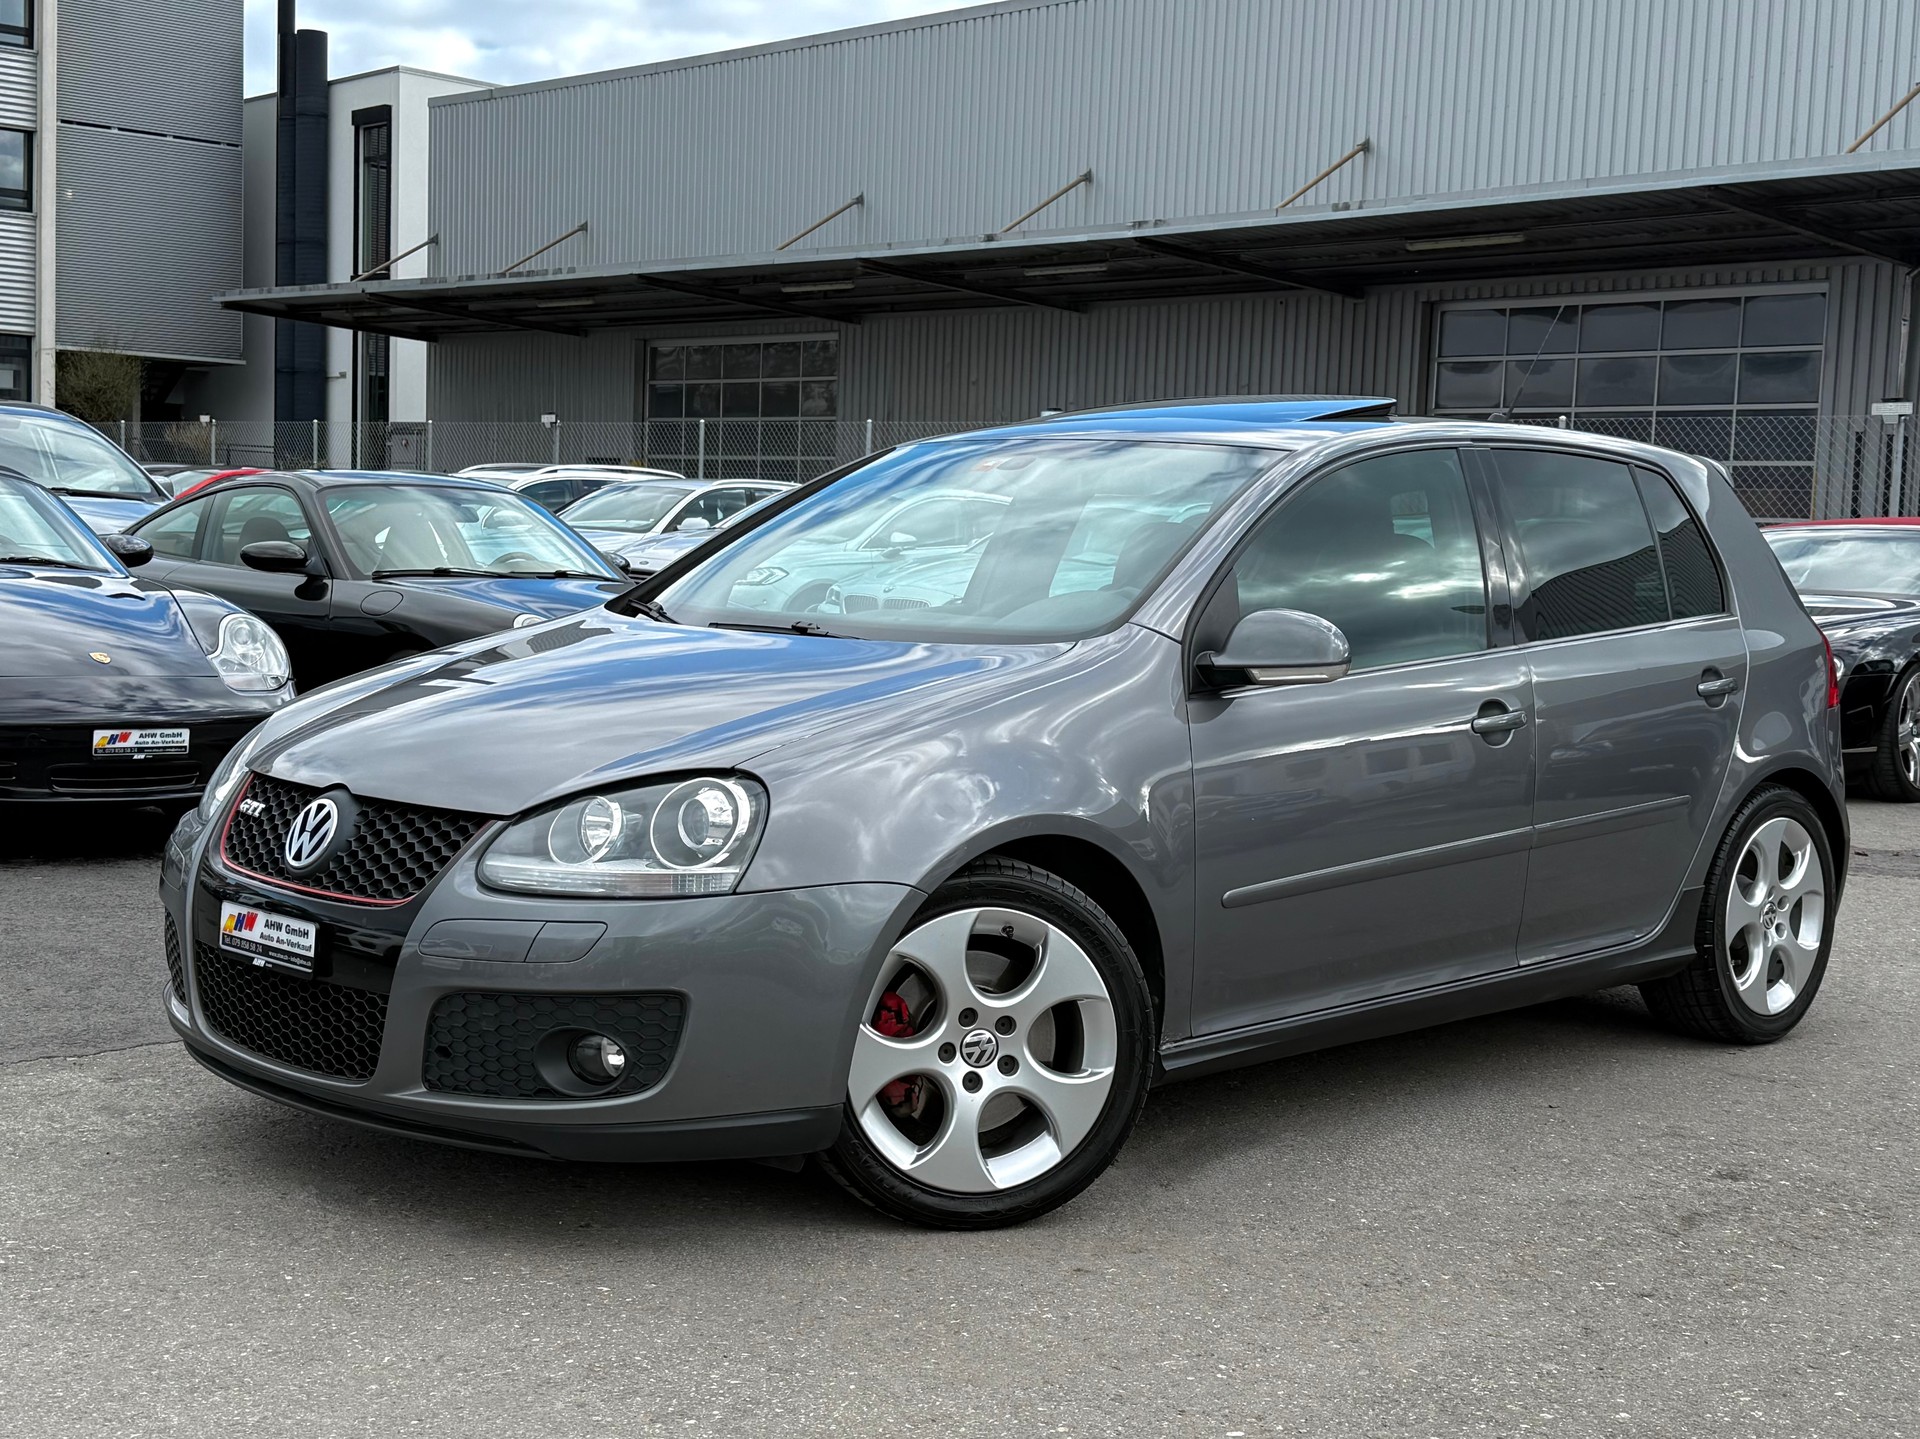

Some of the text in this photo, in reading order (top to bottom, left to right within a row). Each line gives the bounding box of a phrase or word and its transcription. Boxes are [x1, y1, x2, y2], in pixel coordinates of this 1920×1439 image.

[95, 732, 132, 747] AHW
[240, 799, 266, 818] GTI
[286, 798, 338, 867] VW
[223, 911, 258, 933] AHW
[264, 919, 309, 939] AHW GmbH
[260, 932, 312, 952] Auto An-Verkauf
